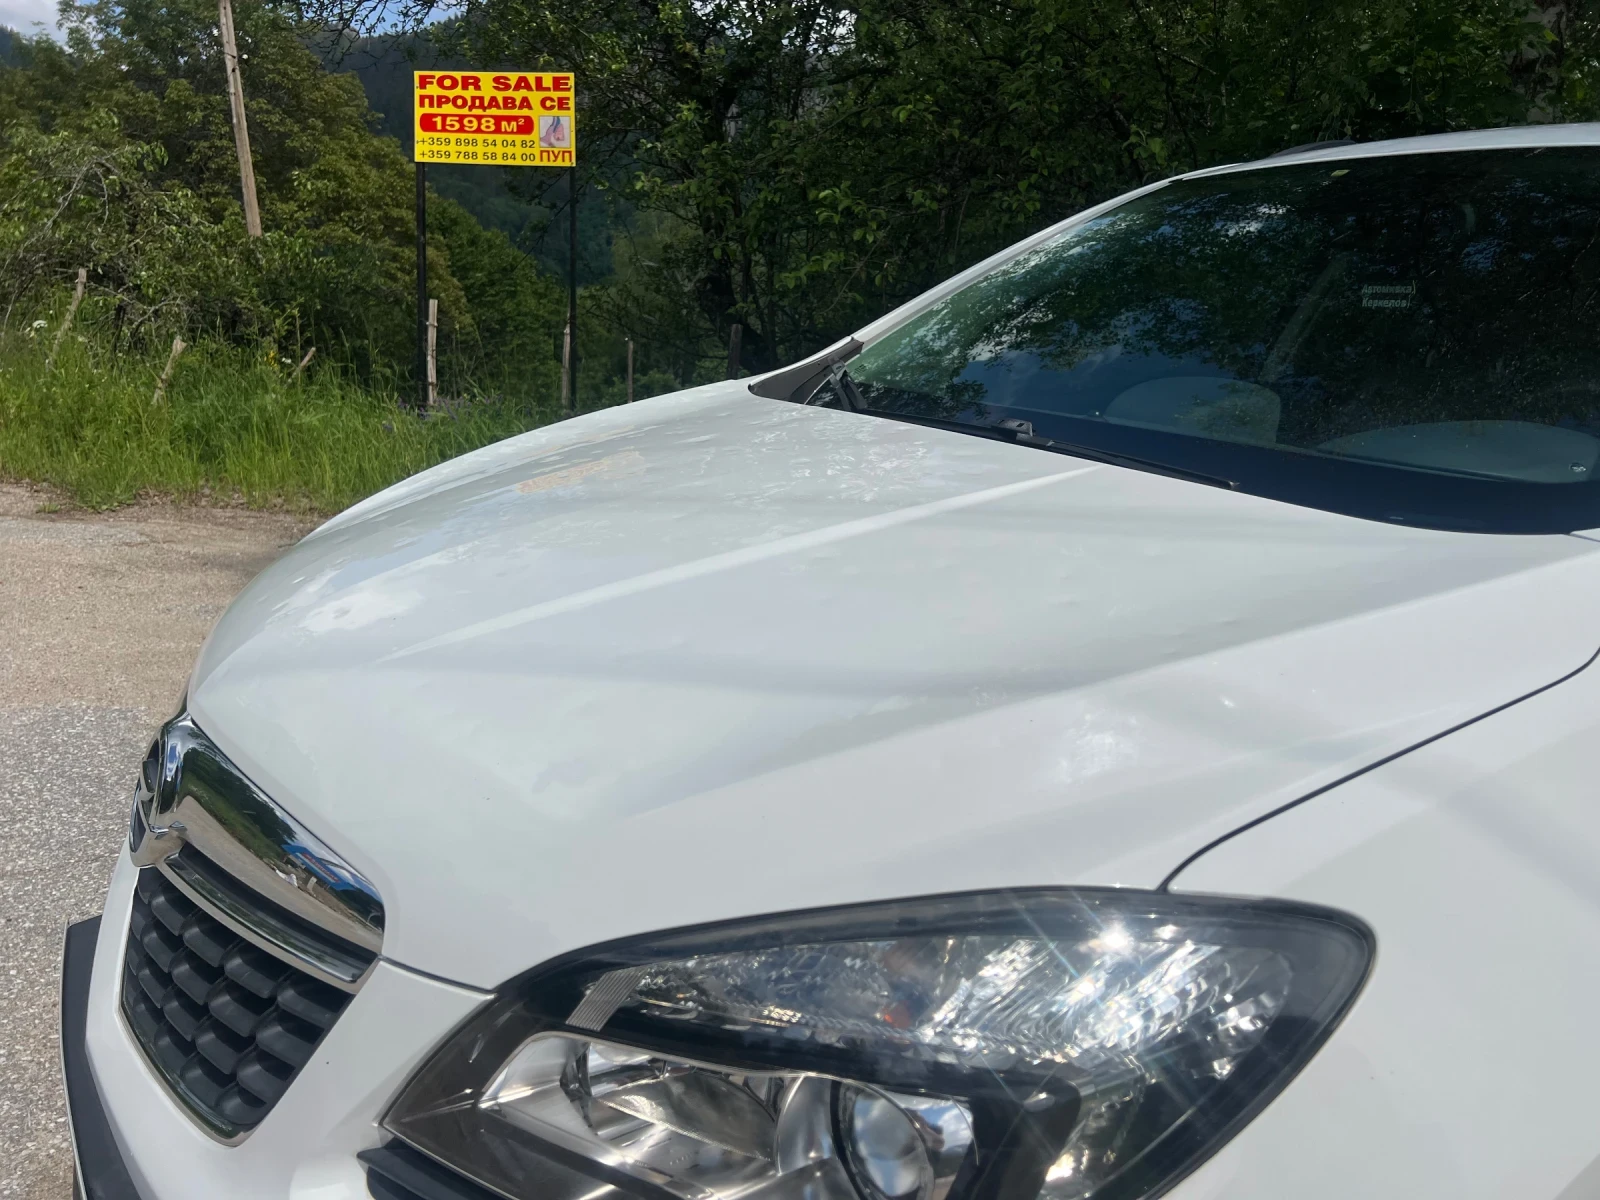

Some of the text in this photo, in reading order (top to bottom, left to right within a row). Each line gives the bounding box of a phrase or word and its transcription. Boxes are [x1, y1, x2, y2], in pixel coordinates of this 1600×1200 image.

[419, 75, 571, 92] FOR SALE
[419, 94, 570, 112] ПРОДАВА СЕ
[432, 116, 496, 132] 1598
[420, 137, 535, 148] +359 898 54 04 82
[419, 150, 536, 161] +359 788 58 84 00
[540, 150, 572, 162] ПУП
